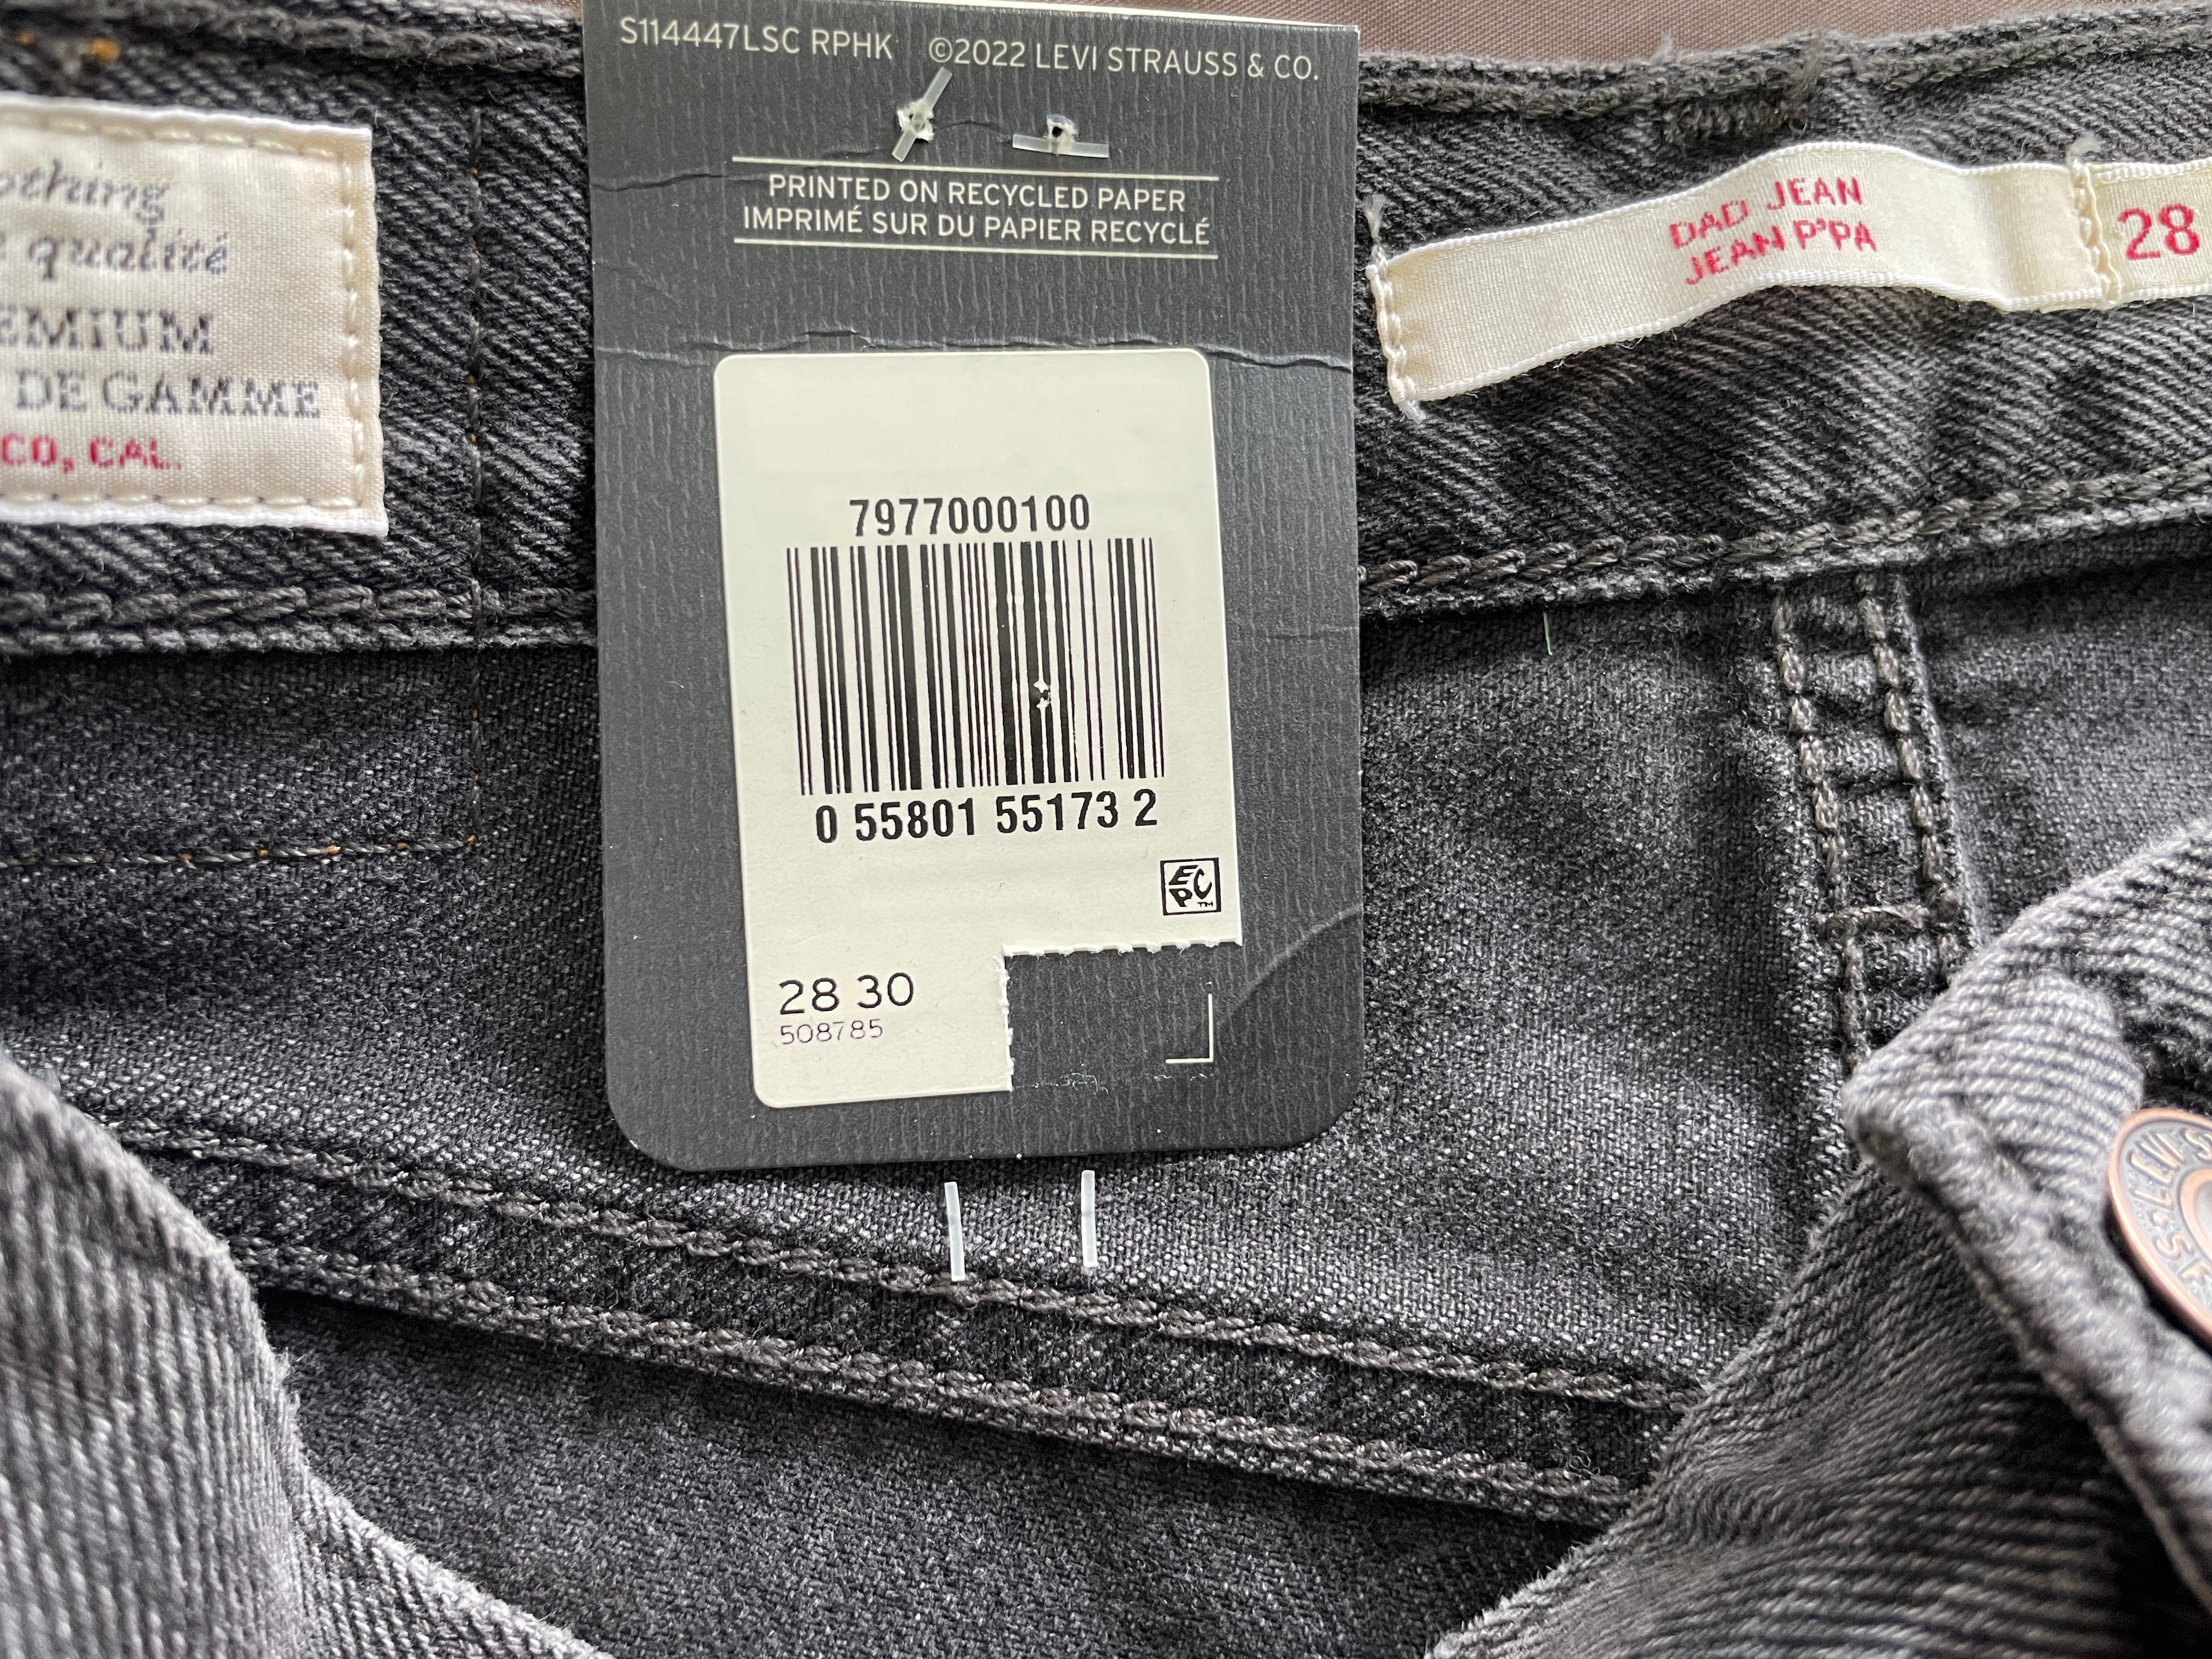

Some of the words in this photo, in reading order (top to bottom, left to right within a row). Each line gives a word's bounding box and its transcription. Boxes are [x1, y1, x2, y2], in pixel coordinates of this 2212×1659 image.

[620, 16, 800, 54] S114447LSC
[812, 29, 893, 60] RPHK
[929, 37, 1025, 67] ©2022
[1036, 43, 1097, 71] LEVI
[1108, 46, 1237, 76] STRAUSS
[1248, 53, 1264, 77] &
[1274, 54, 1318, 81] CO.
[769, 173, 890, 201] PRINTED
[900, 179, 938, 203] ON
[949, 182, 1088, 209] RECYCLED
[1098, 187, 1185, 212] PAPER
[1669, 200, 1750, 249] DAD
[1767, 177, 1863, 211] JEAN
[744, 205, 862, 233] IMPRIMÉ
[872, 211, 928, 236] SUR
[938, 214, 974, 237] DU
[985, 216, 1081, 241] PAPIER
[1091, 217, 1210, 245] RECYCLÉ
[2117, 203, 2201, 261] 28
[28, 226, 228, 280] qualité
[1685, 225, 1786, 286] JEAN
[1793, 218, 1877, 251] P'PA
[15, 368, 88, 413] DE
[102, 371, 323, 419] GAMME
[850, 494, 1090, 537] 7977000100
[816, 805, 837, 843] 0
[855, 798, 975, 841] 55801
[996, 791, 1118, 833] 55173
[1133, 788, 1158, 826] 2
[779, 978, 839, 1015] 28
[857, 973, 913, 1008] 30
[781, 1019, 883, 1045] 508785
